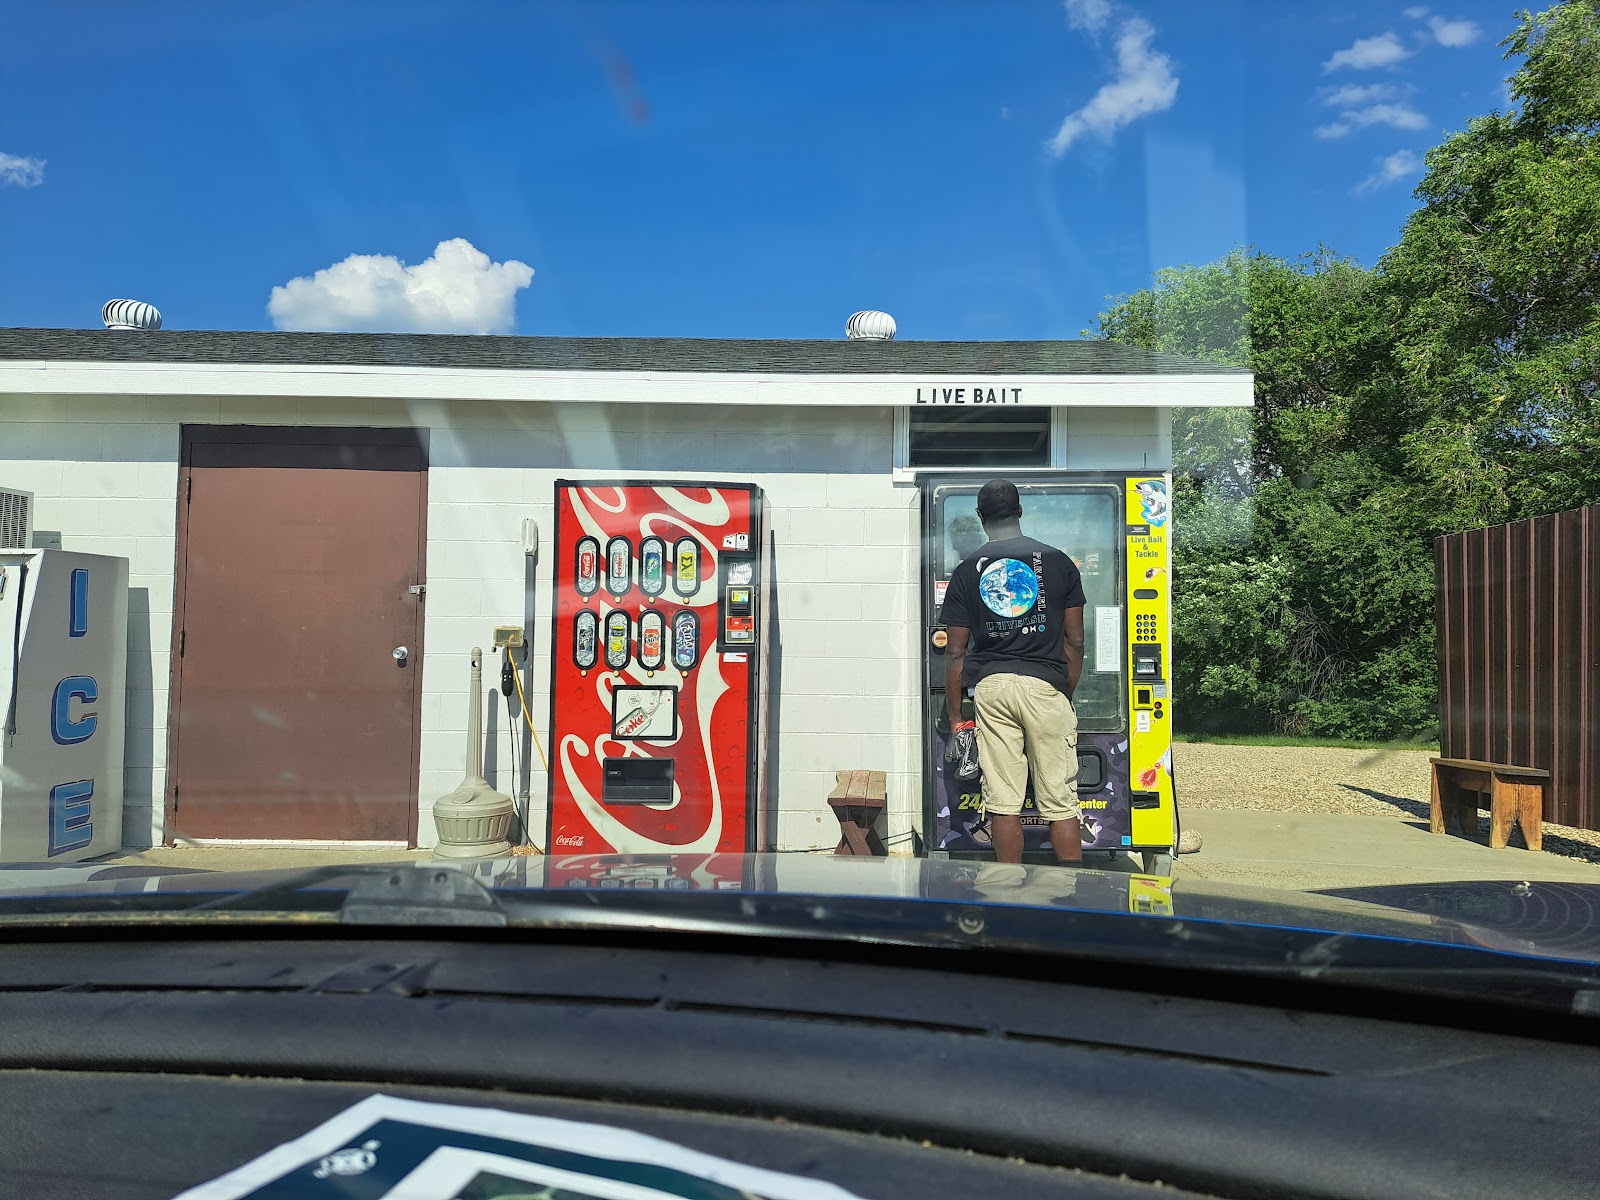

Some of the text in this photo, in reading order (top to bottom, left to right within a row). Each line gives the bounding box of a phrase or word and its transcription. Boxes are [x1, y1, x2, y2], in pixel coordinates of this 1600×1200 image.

[916, 388, 1022, 404] LIVE BAIT
[985, 613, 1047, 631] UNIVERSE
[681, 621, 695, 648] Fanta
[48, 568, 99, 859] ICE
[1024, 798, 1034, 809] &
[555, 834, 585, 847] Coca-Cola
